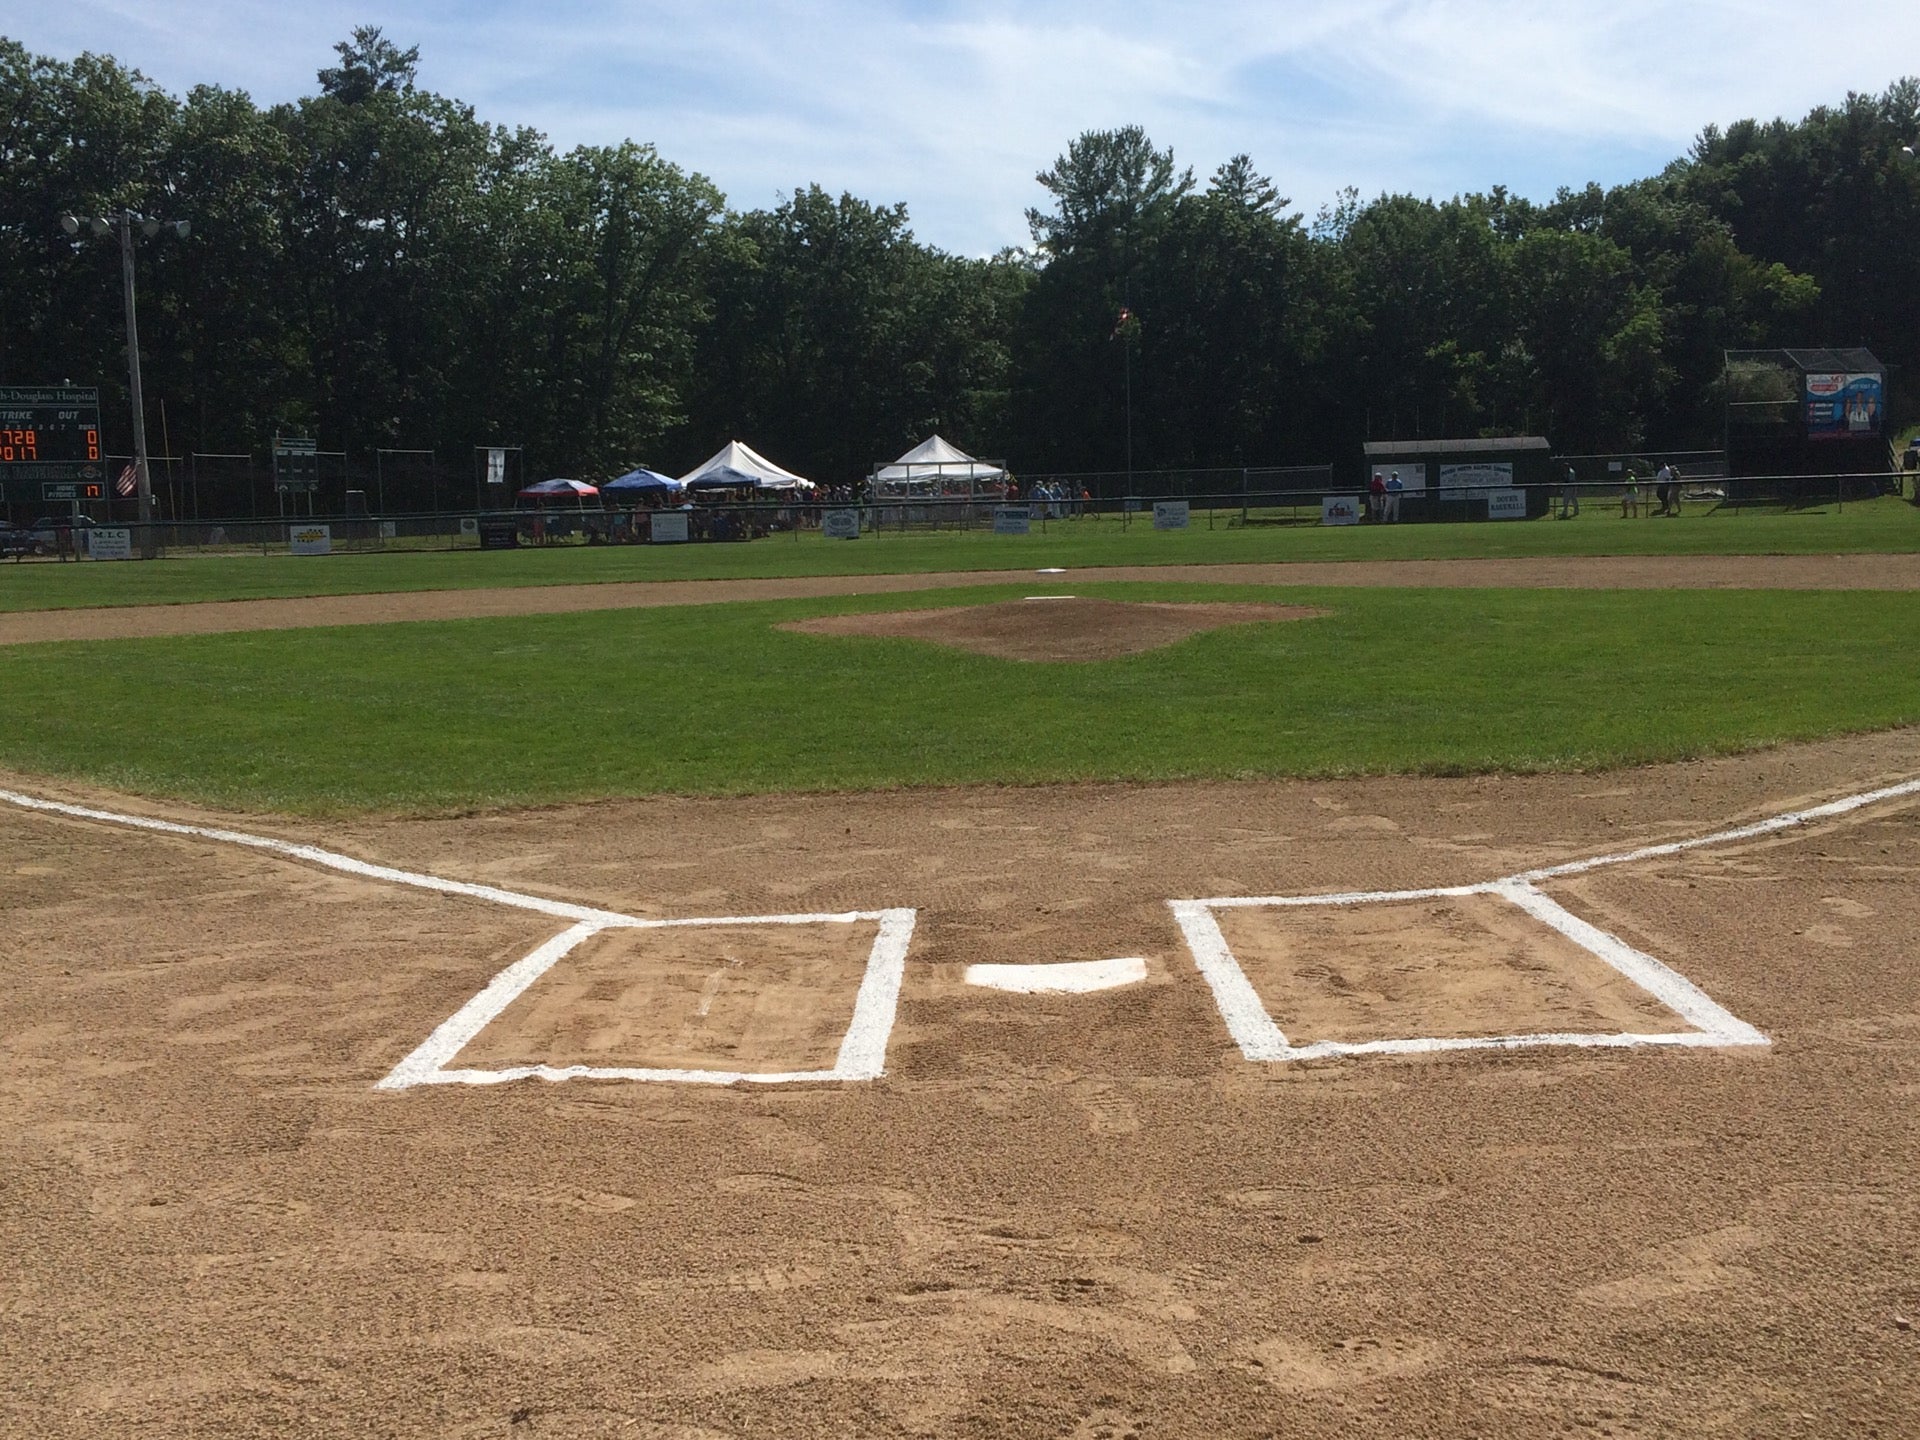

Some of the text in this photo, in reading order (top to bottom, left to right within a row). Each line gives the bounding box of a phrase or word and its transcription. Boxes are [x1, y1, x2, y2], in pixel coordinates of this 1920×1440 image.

[56, 390, 97, 403] Hospital
[57, 410, 80, 420] OUT
[0, 430, 97, 445] 728 0
[0, 446, 98, 460] 017 0
[87, 485, 99, 497] 17
